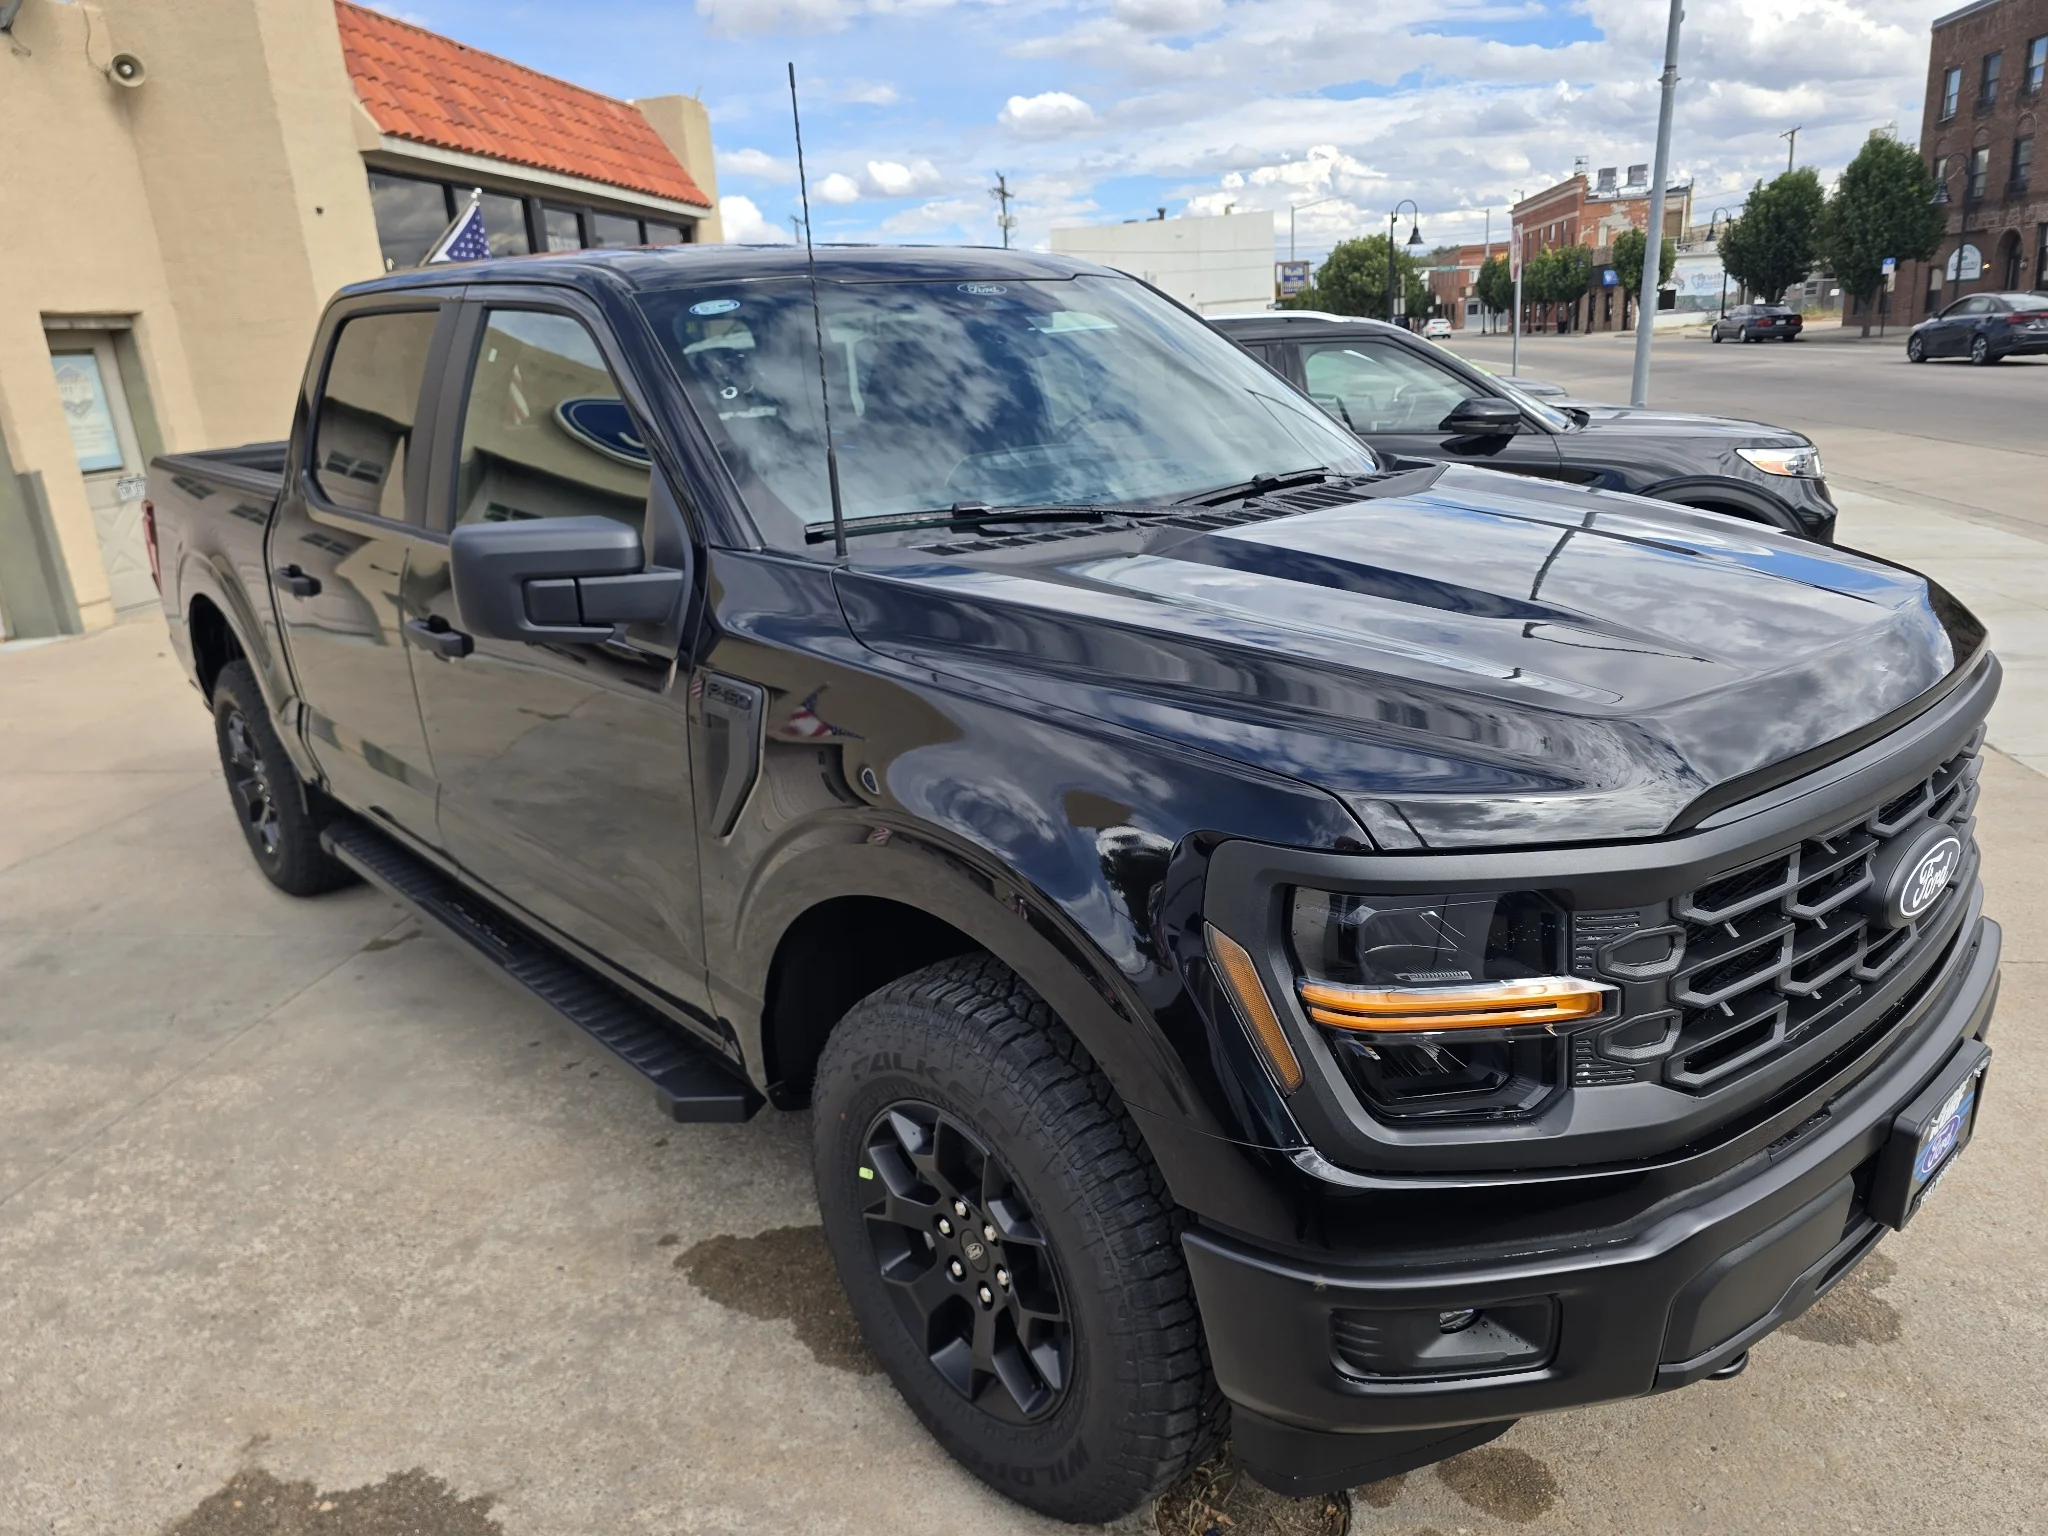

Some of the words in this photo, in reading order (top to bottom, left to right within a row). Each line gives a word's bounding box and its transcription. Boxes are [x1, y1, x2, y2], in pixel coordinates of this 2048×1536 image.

[967, 284, 999, 293] Ford
[1912, 850, 1953, 908] Ford
[850, 1050, 1014, 1146] FALKEN
[1927, 1125, 1955, 1167] Ford
